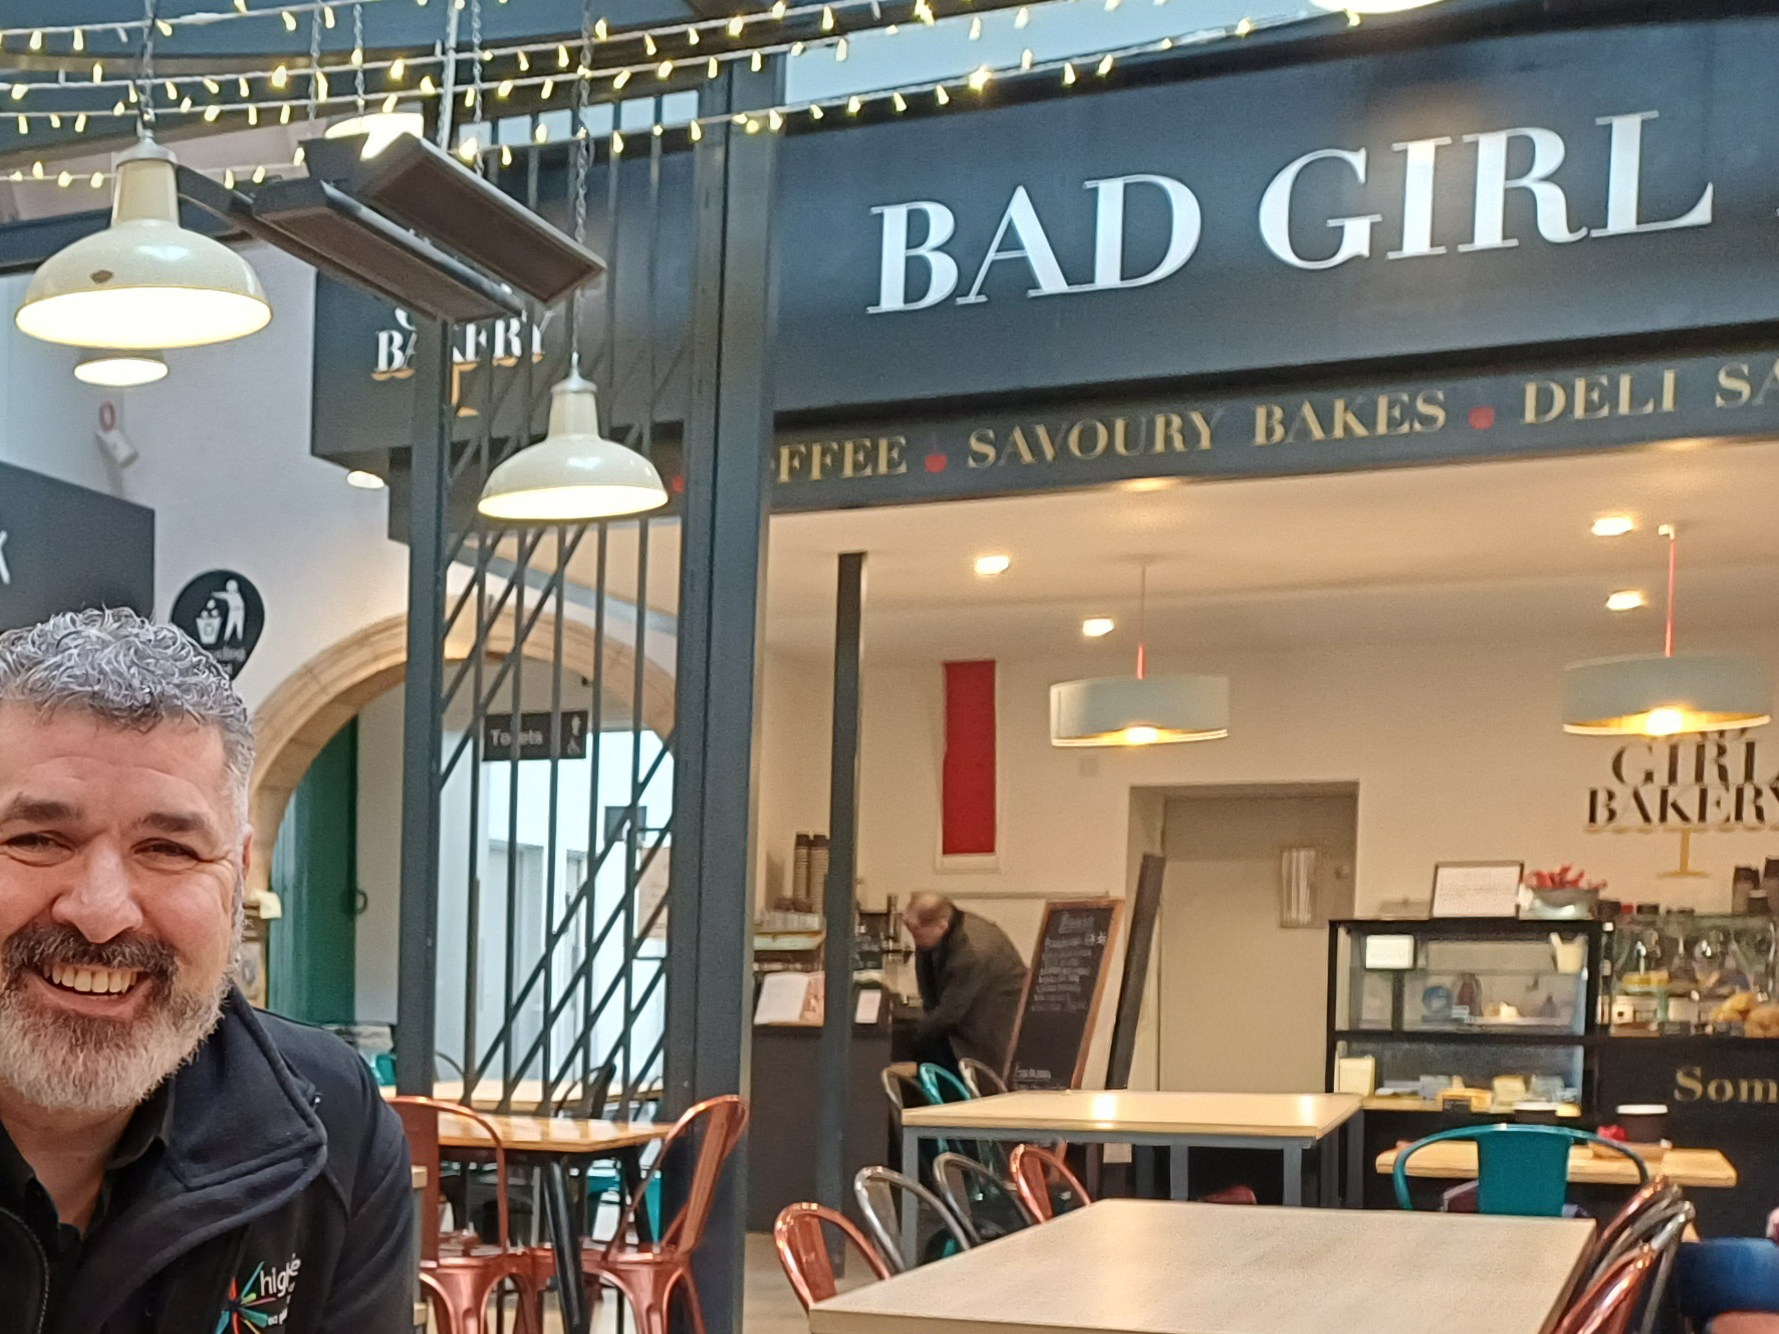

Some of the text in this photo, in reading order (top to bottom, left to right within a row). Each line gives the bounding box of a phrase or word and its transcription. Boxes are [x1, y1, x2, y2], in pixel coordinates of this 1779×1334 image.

[867, 110, 1715, 315] BAD GIRL
[772, 435, 908, 484] FFEE
[966, 407, 1223, 469] SAVOURY
[1253, 389, 1448, 446] BAKES
[1522, 369, 1677, 426] DELI
[490, 728, 543, 747] Toets
[1588, 784, 1779, 824] BAKER
